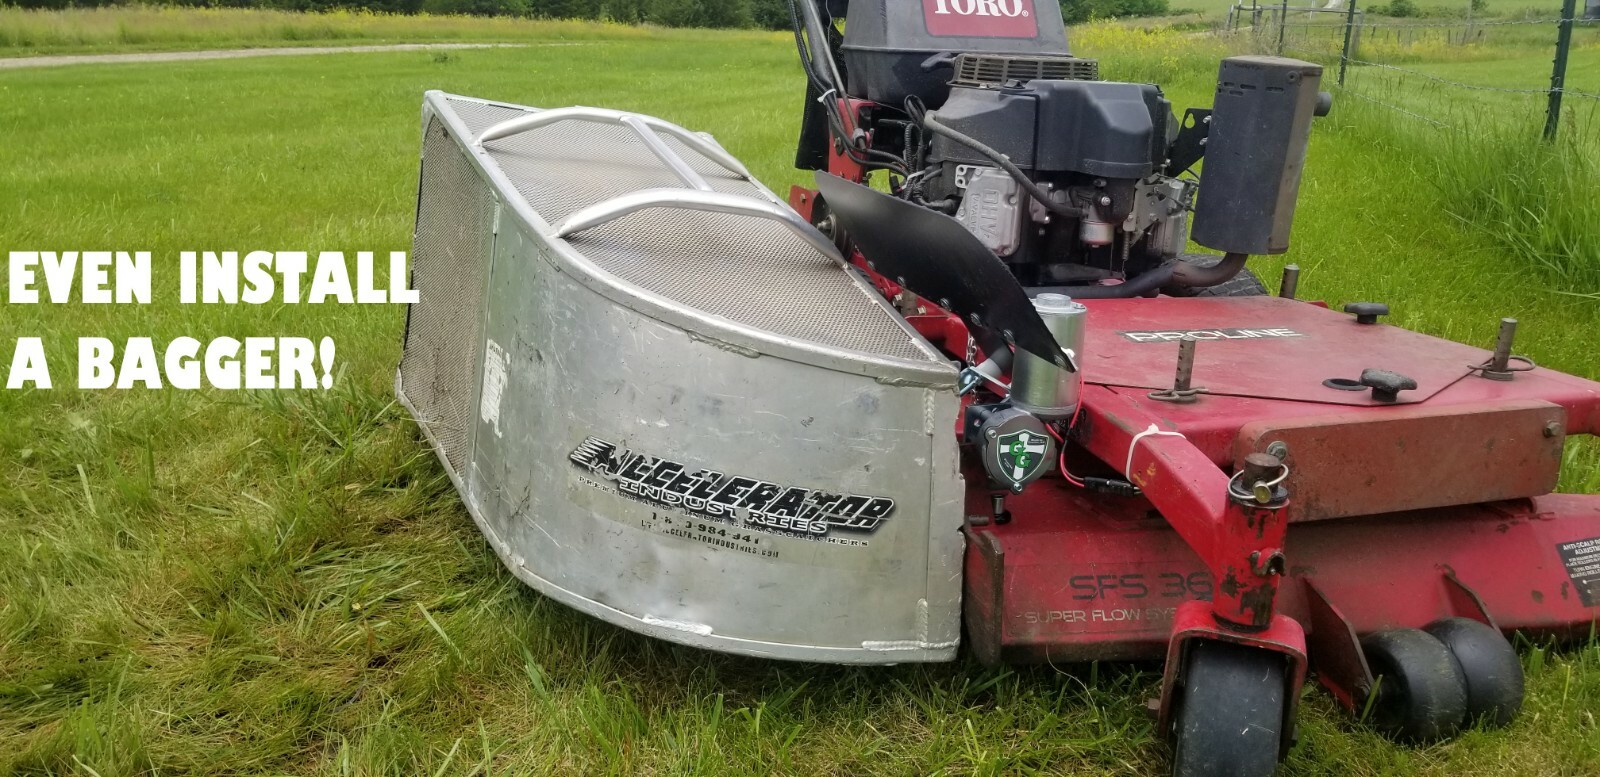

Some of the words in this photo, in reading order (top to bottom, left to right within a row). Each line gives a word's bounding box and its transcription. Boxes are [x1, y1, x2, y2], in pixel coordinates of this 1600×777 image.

[934, 0, 1023, 17] TORO
[1126, 328, 1302, 342] PROLINE
[620, 478, 827, 533] INDUSTRIES
[1069, 573, 1148, 600] SFS
[1158, 571, 1214, 601] 36
[1025, 610, 1087, 624] SUPER
[1092, 608, 1140, 622] FLOW
